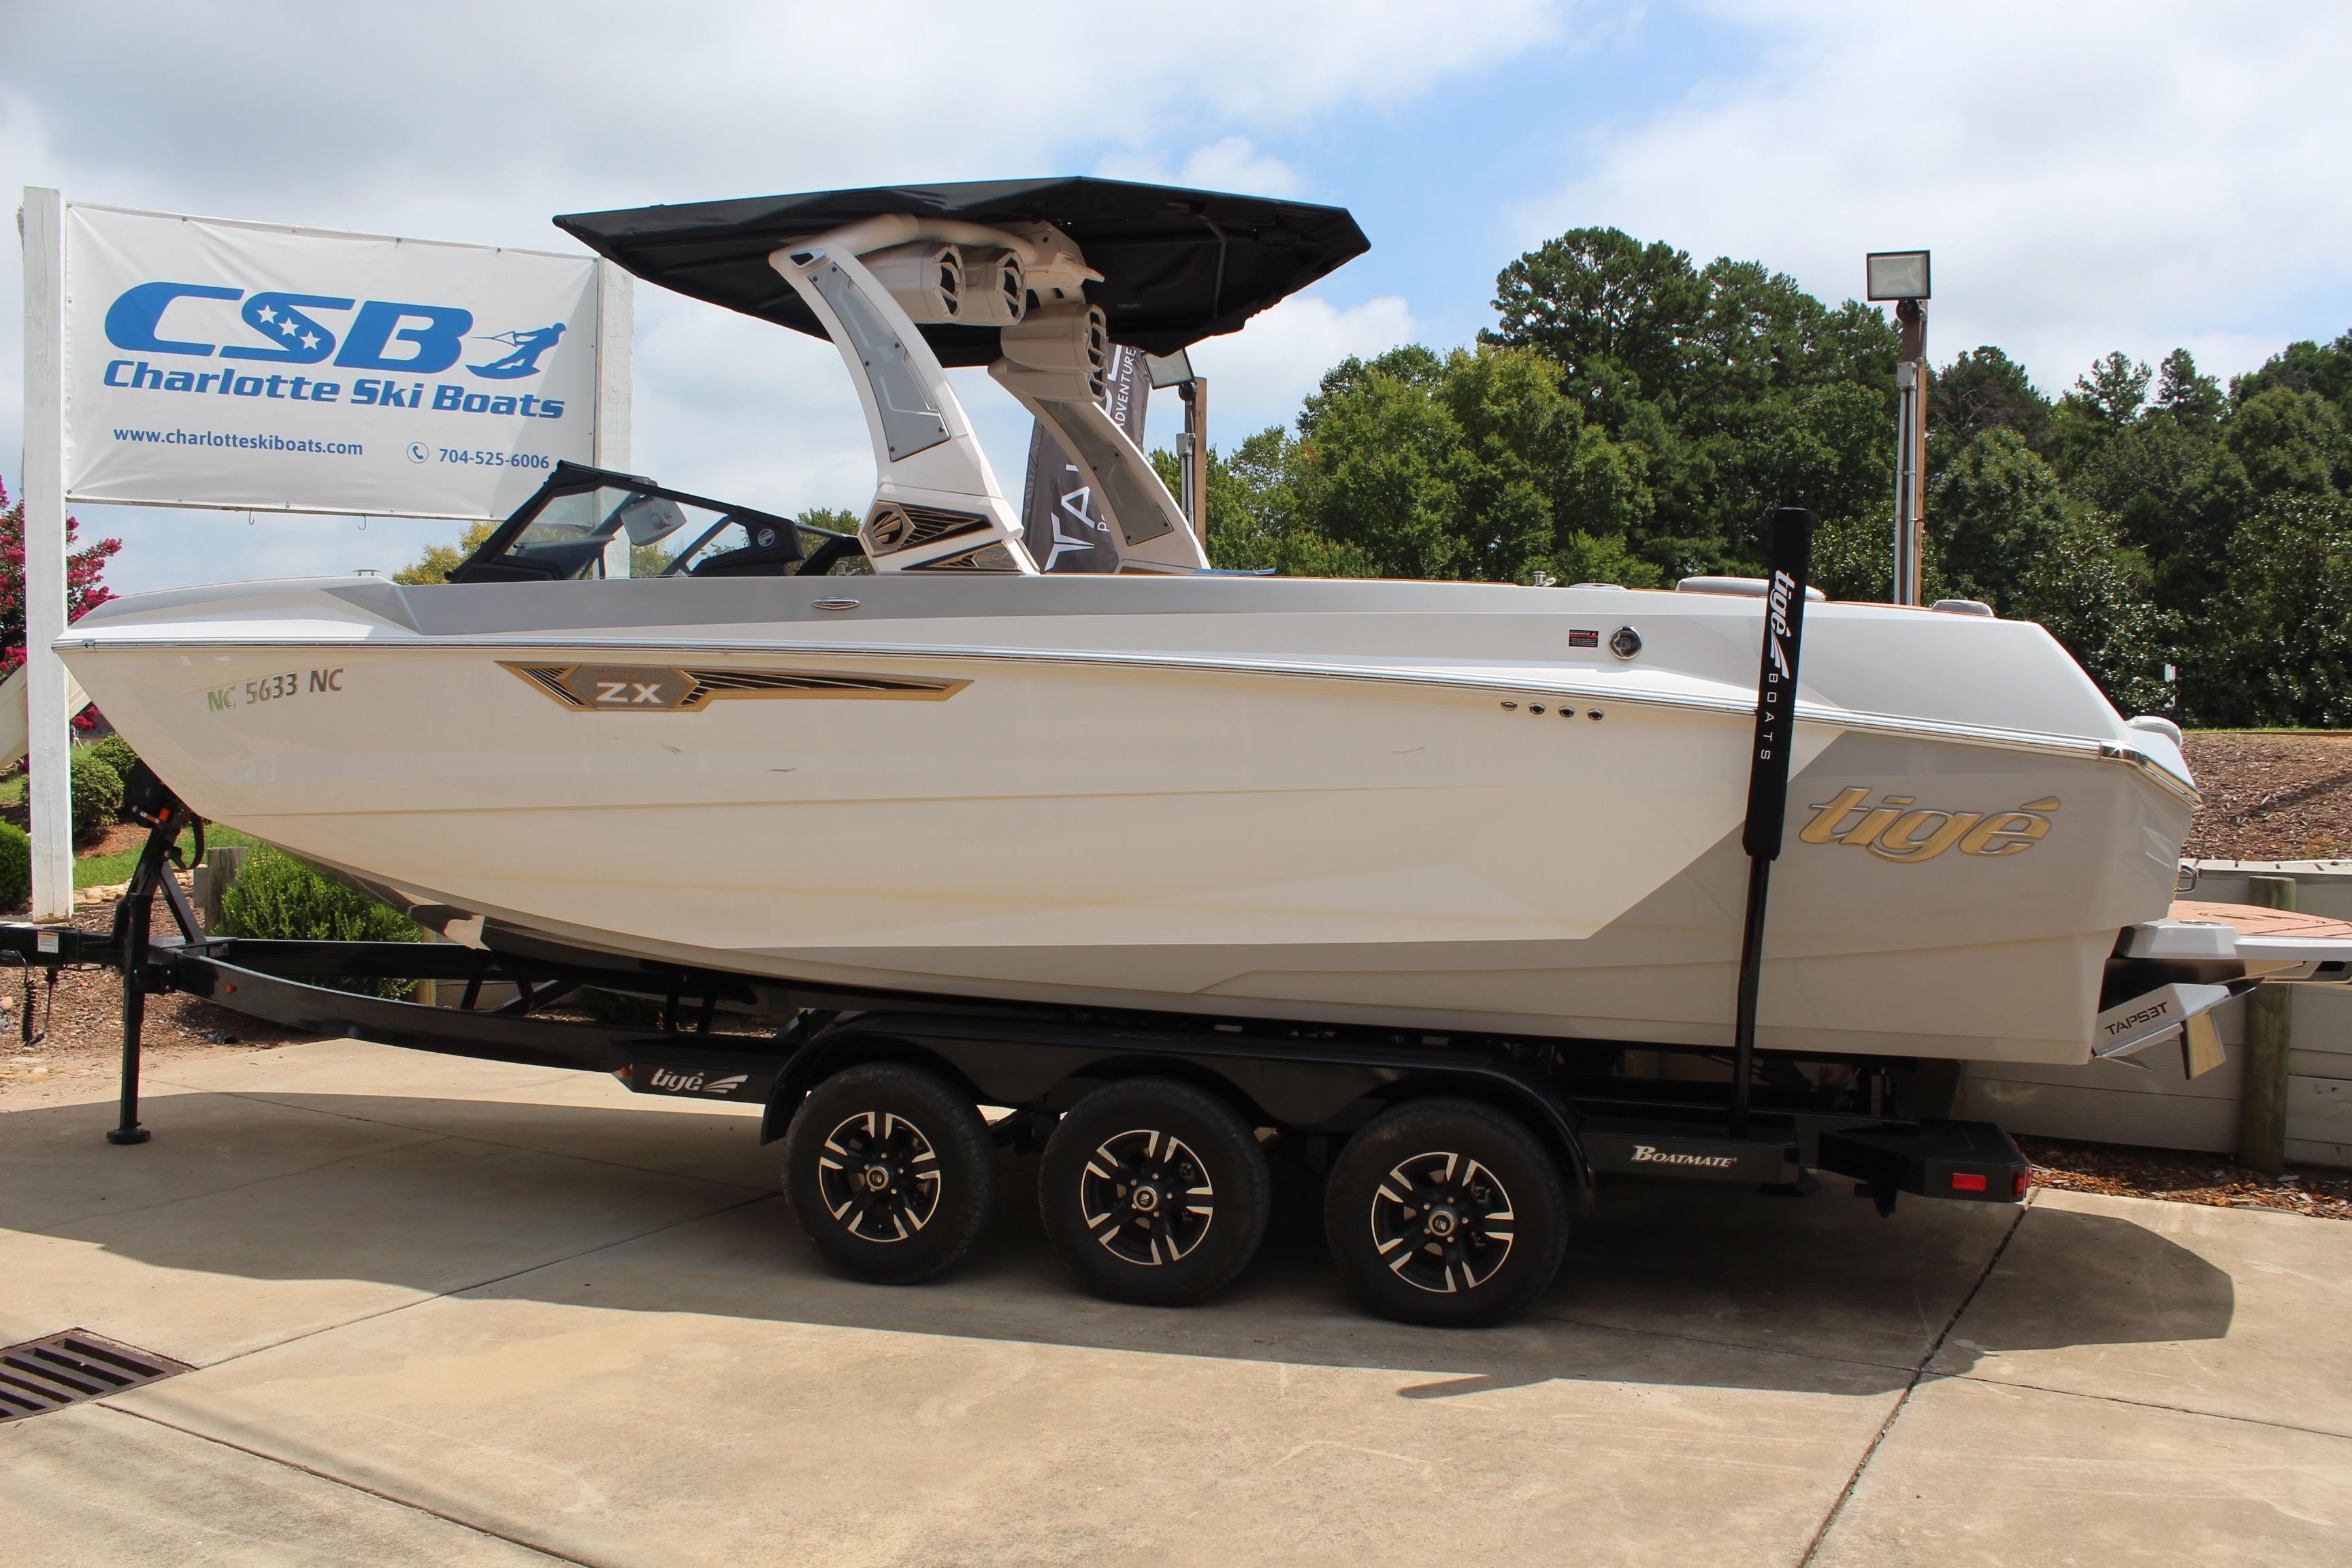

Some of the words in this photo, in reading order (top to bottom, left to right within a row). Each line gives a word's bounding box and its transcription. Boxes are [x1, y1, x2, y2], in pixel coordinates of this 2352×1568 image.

[105, 281, 473, 374] CSB
[103, 359, 340, 402] Charlotte
[350, 378, 423, 408] Ski
[431, 384, 566, 419] Boats
[113, 427, 363, 455] www.charlotteskiboats.com
[438, 447, 550, 470] 704-525-6006
[1769, 570, 1796, 638] tigé
[207, 685, 237, 713] NC
[246, 672, 298, 705] 5633
[309, 668, 344, 693] NC
[596, 682, 664, 704] ZX
[1761, 673, 1779, 760] BOATS
[1799, 786, 2061, 863] tigé
[651, 1068, 705, 1092] tigé
